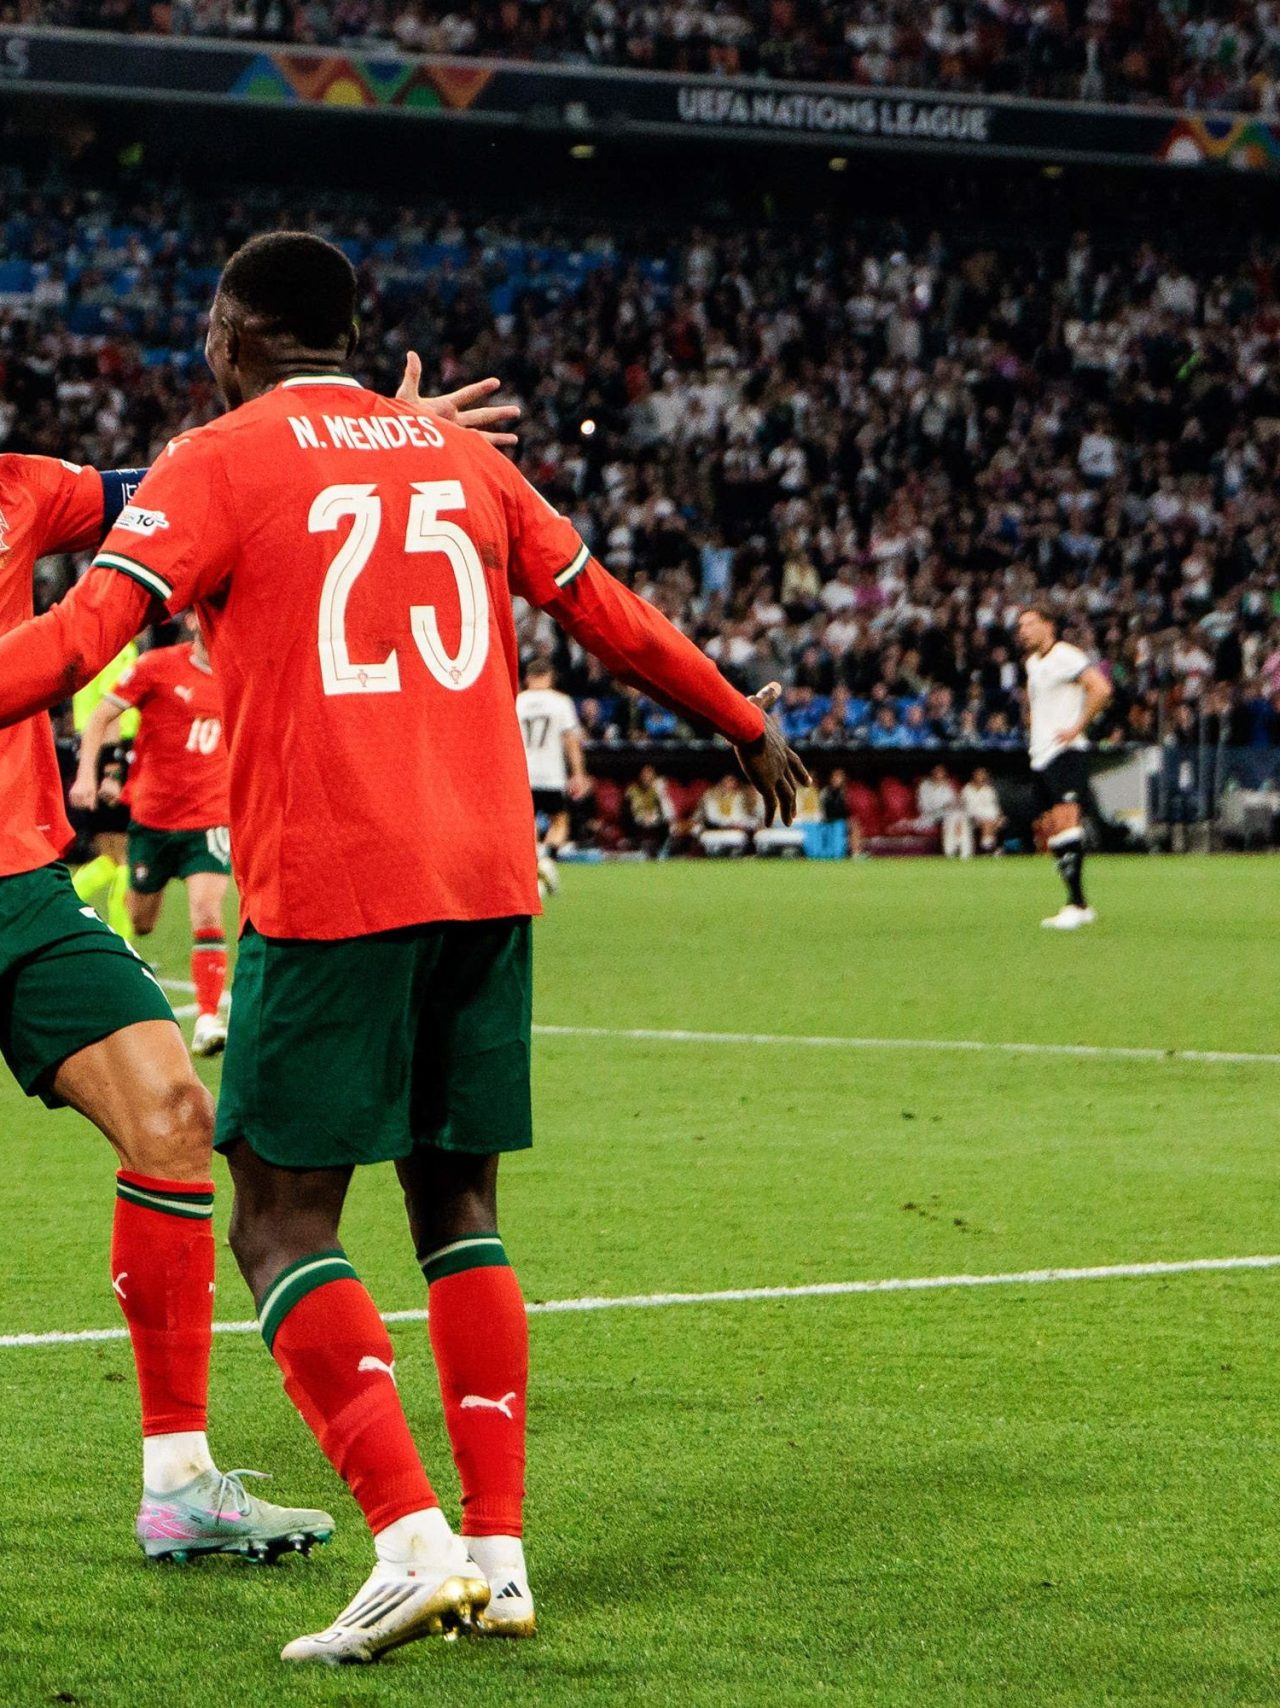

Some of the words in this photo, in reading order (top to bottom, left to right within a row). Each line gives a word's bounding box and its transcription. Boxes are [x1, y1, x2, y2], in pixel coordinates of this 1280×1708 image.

[677, 87, 749, 122] UEFA
[751, 94, 876, 133] NATIONS
[880, 102, 989, 141] LEAGUE
[287, 416, 326, 449] N.
[327, 414, 445, 450] MENDES
[307, 480, 489, 696] 25
[185, 717, 222, 755] 10
[522, 714, 551, 748] 17
